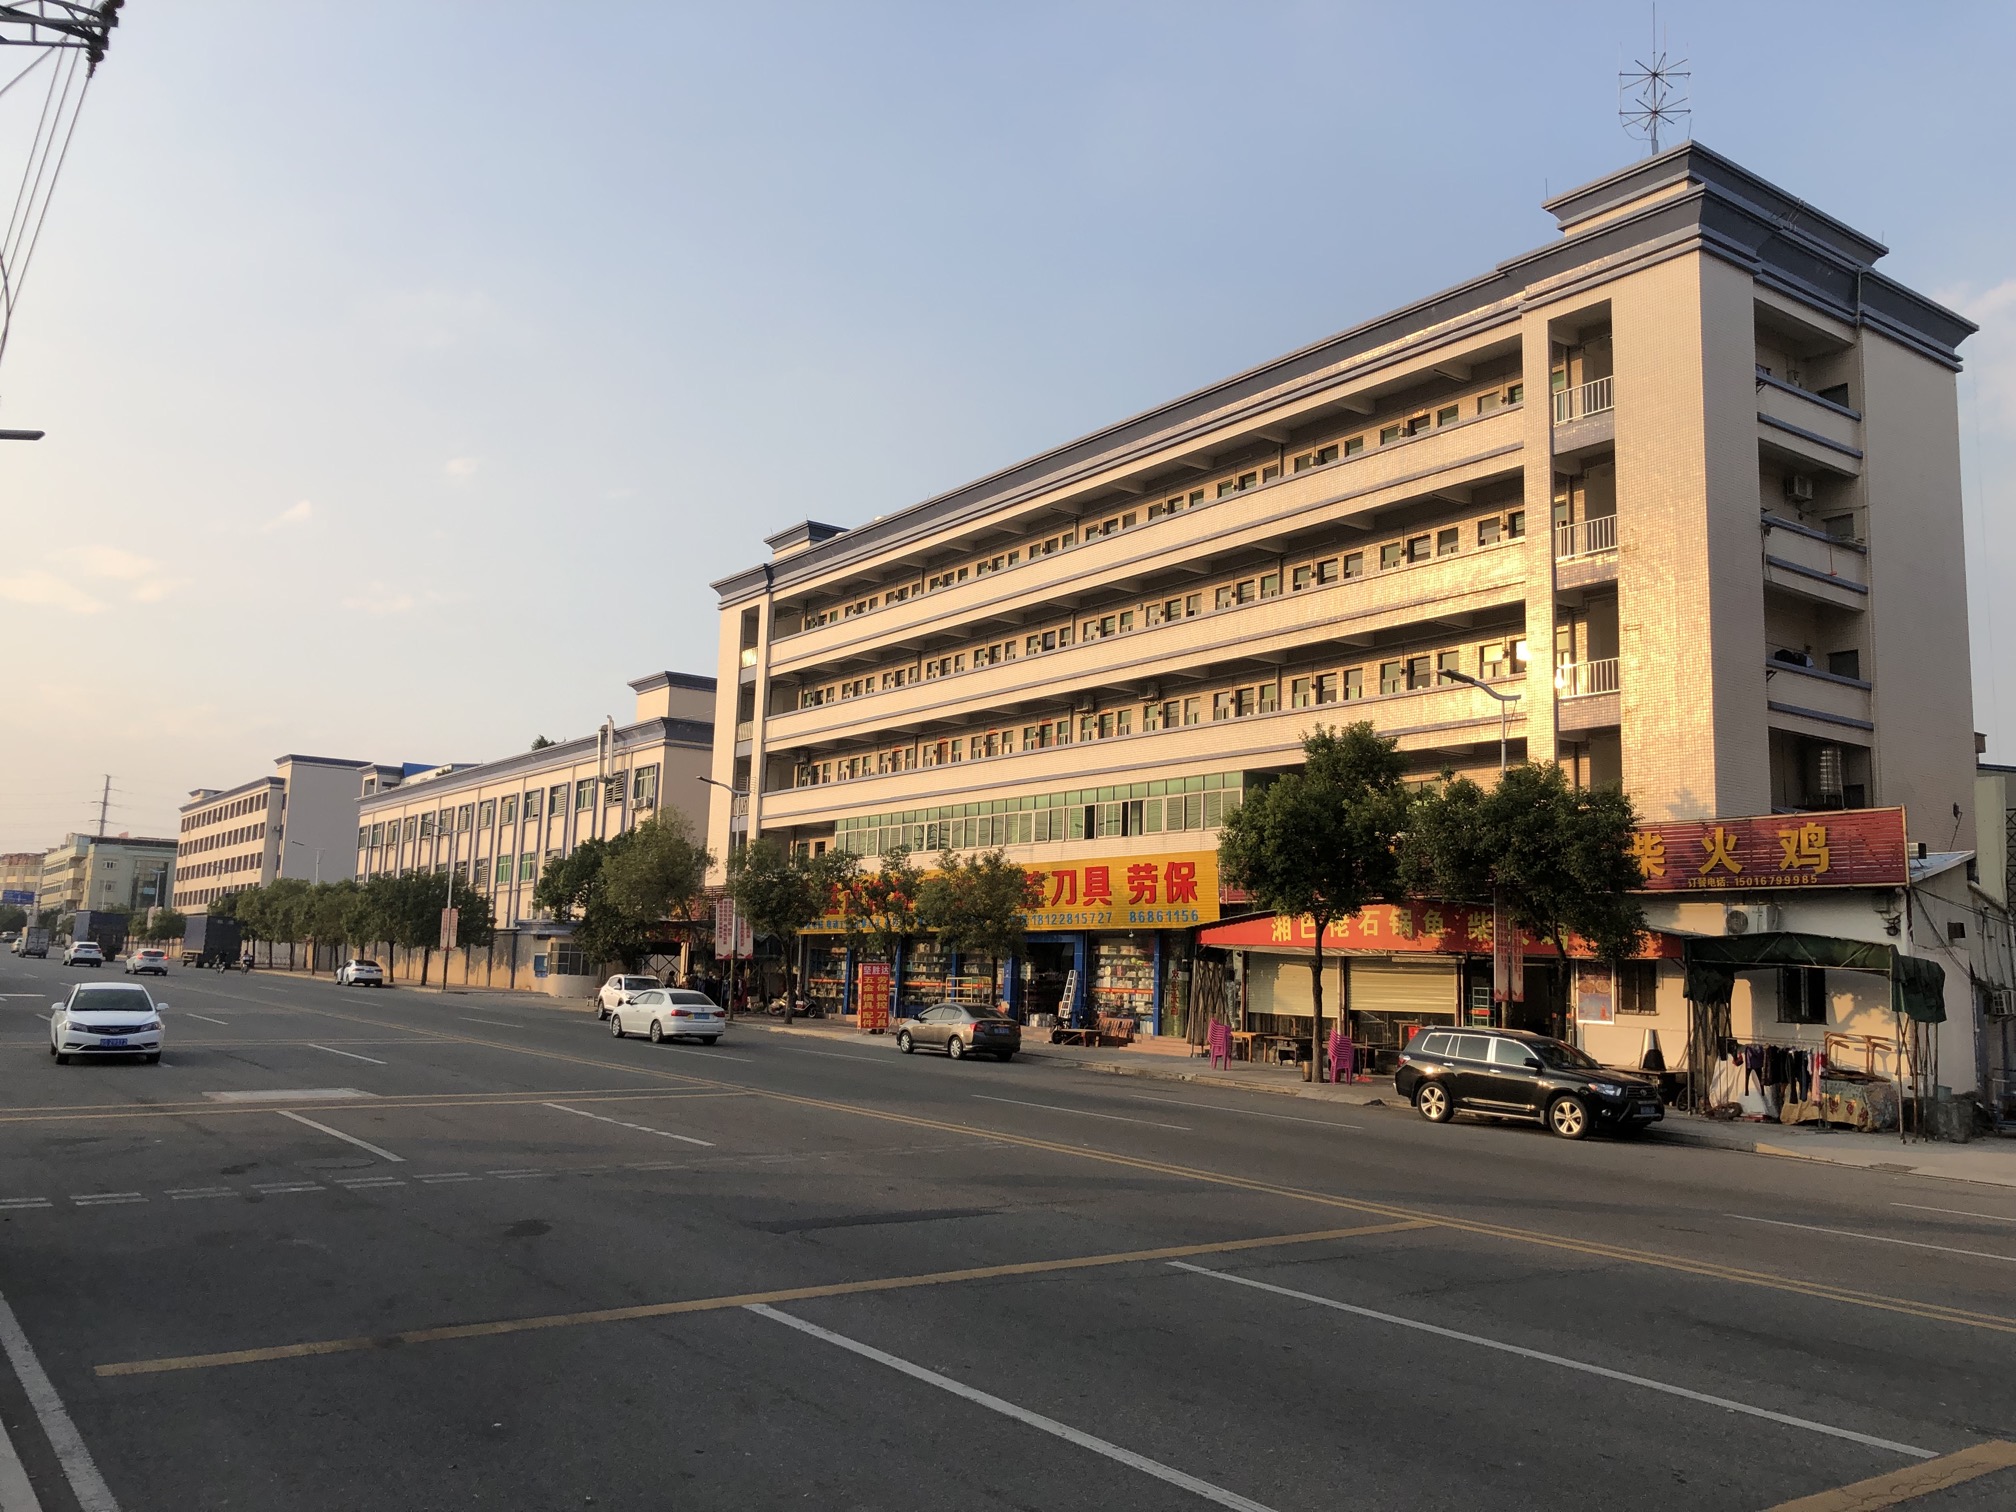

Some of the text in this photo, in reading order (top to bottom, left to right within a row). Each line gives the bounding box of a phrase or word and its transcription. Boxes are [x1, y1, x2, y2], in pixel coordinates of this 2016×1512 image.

[1127, 861, 1198, 905] 劳保
[1734, 875, 1818, 887] 15016799985
[1031, 912, 1113, 925] 18122815727
[1128, 909, 1199, 923] 86861156
[863, 965, 889, 975] 坚胜达
